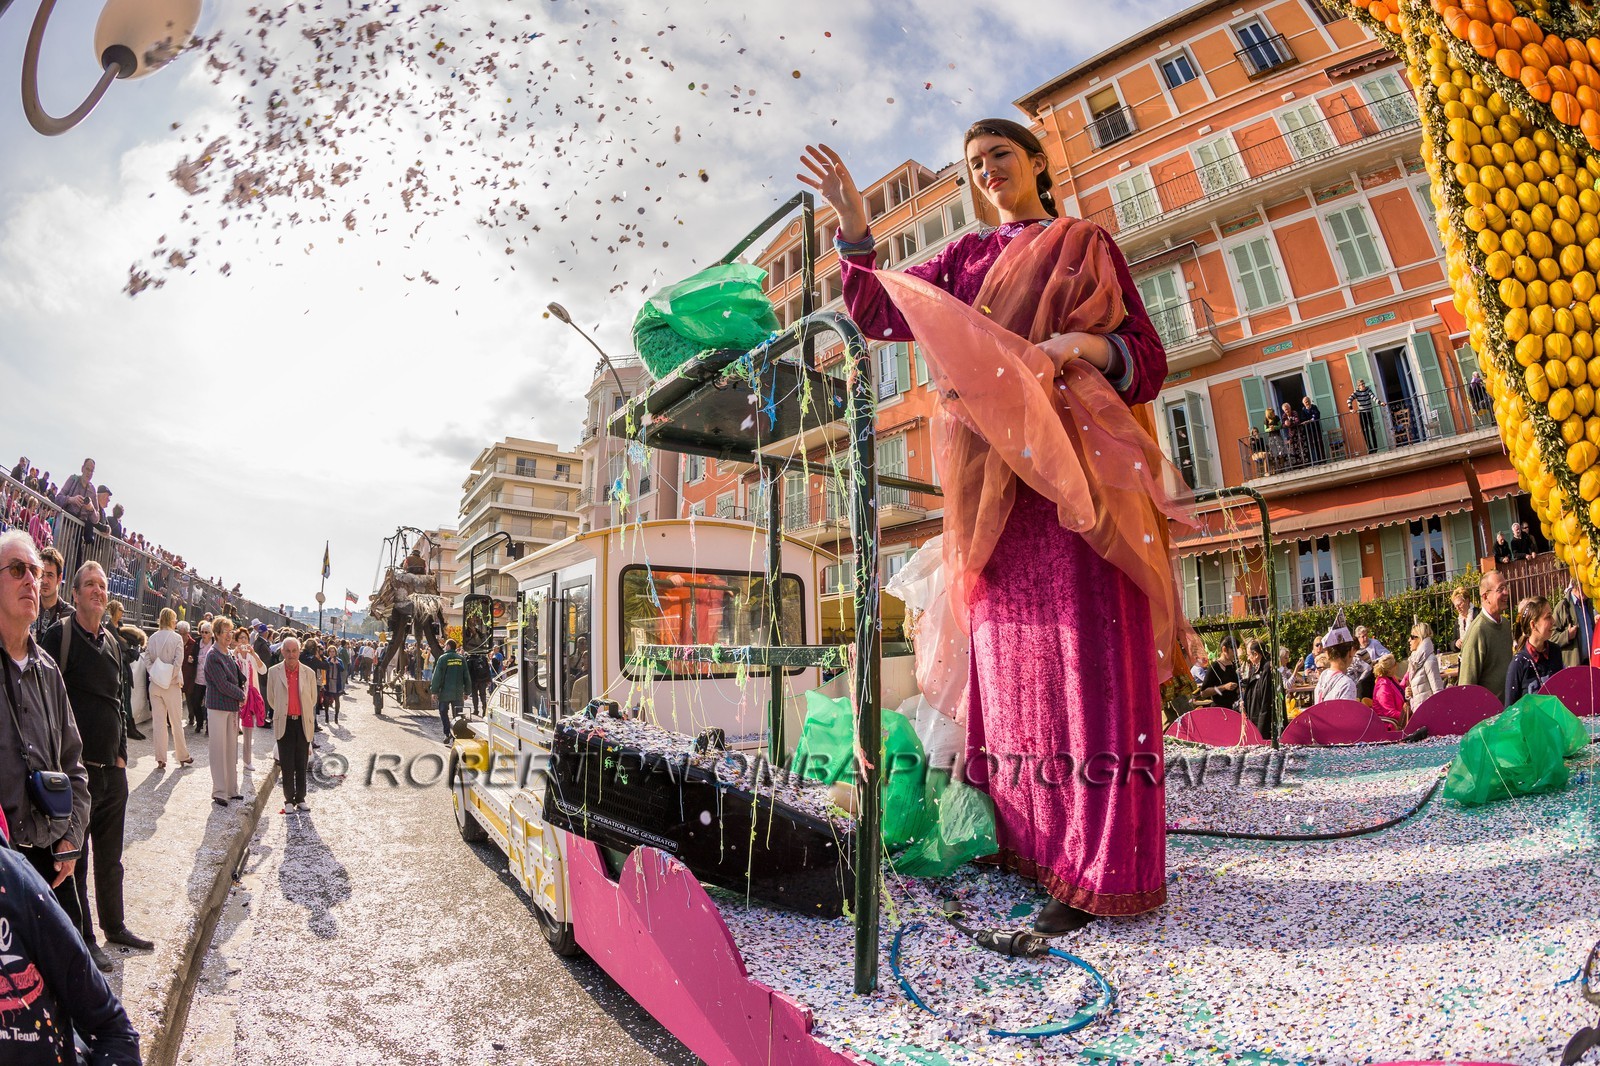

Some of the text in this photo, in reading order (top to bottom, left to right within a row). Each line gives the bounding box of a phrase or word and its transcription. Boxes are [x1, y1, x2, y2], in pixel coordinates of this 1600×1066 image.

[593, 814, 626, 831] OPERATION
[626, 826, 640, 836] FOG
[640, 831, 677, 849] GENERATOR
[9, 1026, 40, 1042] Team
